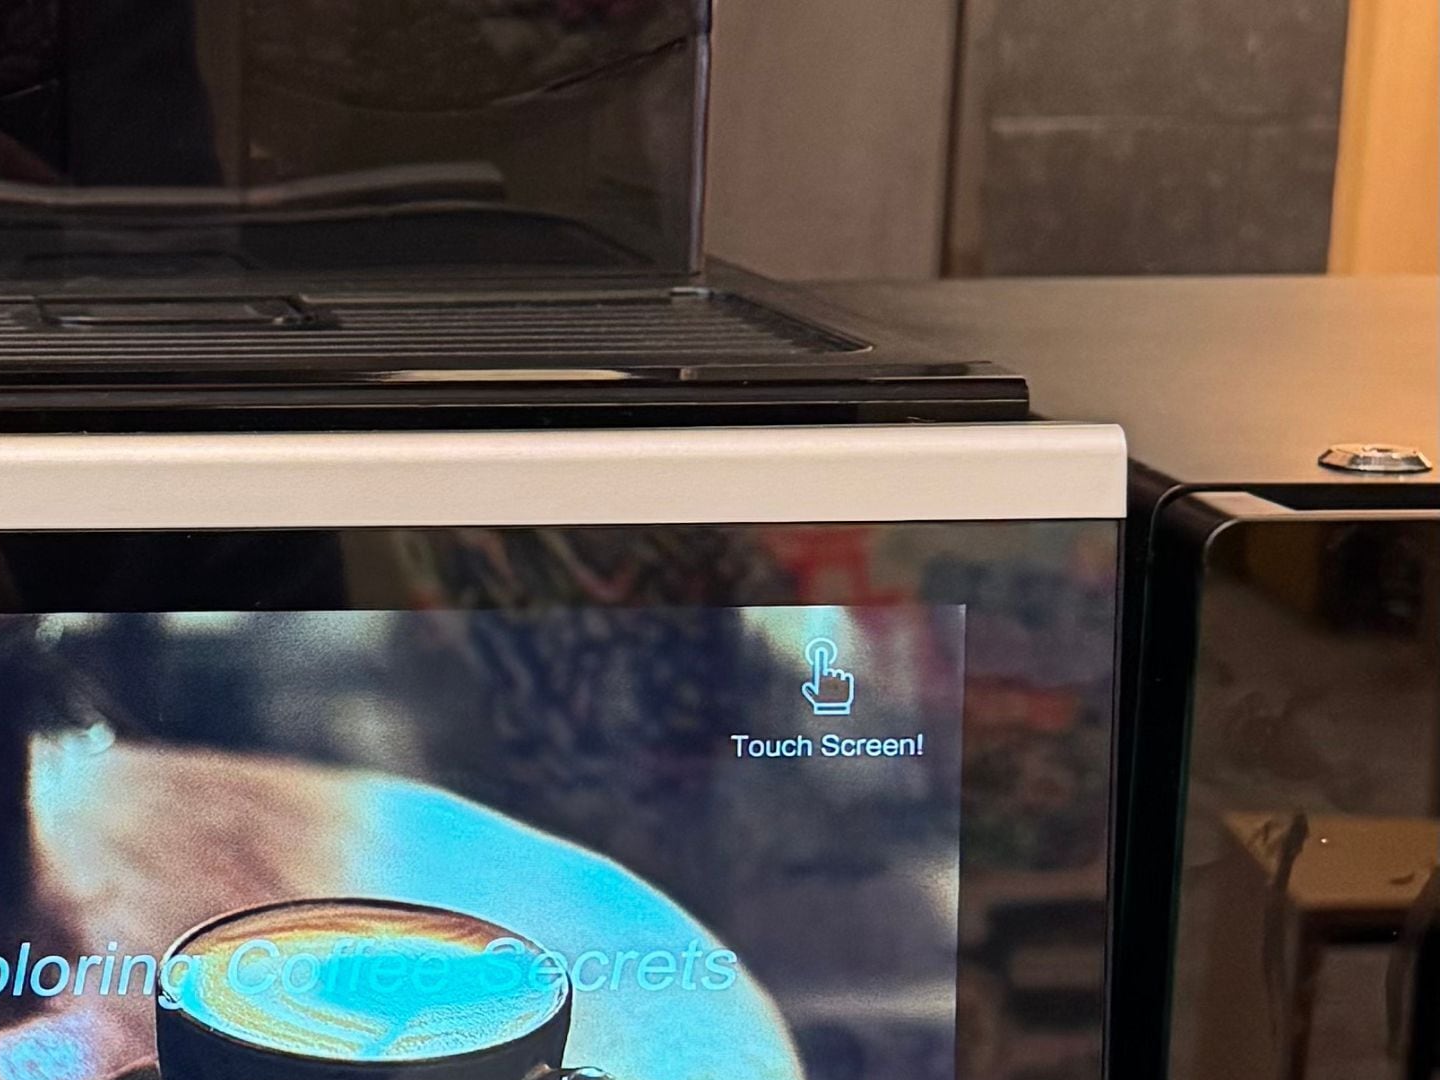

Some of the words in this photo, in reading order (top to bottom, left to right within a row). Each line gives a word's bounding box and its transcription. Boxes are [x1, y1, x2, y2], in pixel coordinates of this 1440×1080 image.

[730, 734, 812, 757] Touch
[821, 733, 924, 757] Screen!
[227, 938, 452, 995] Coffee
[481, 937, 738, 994] Secrets
